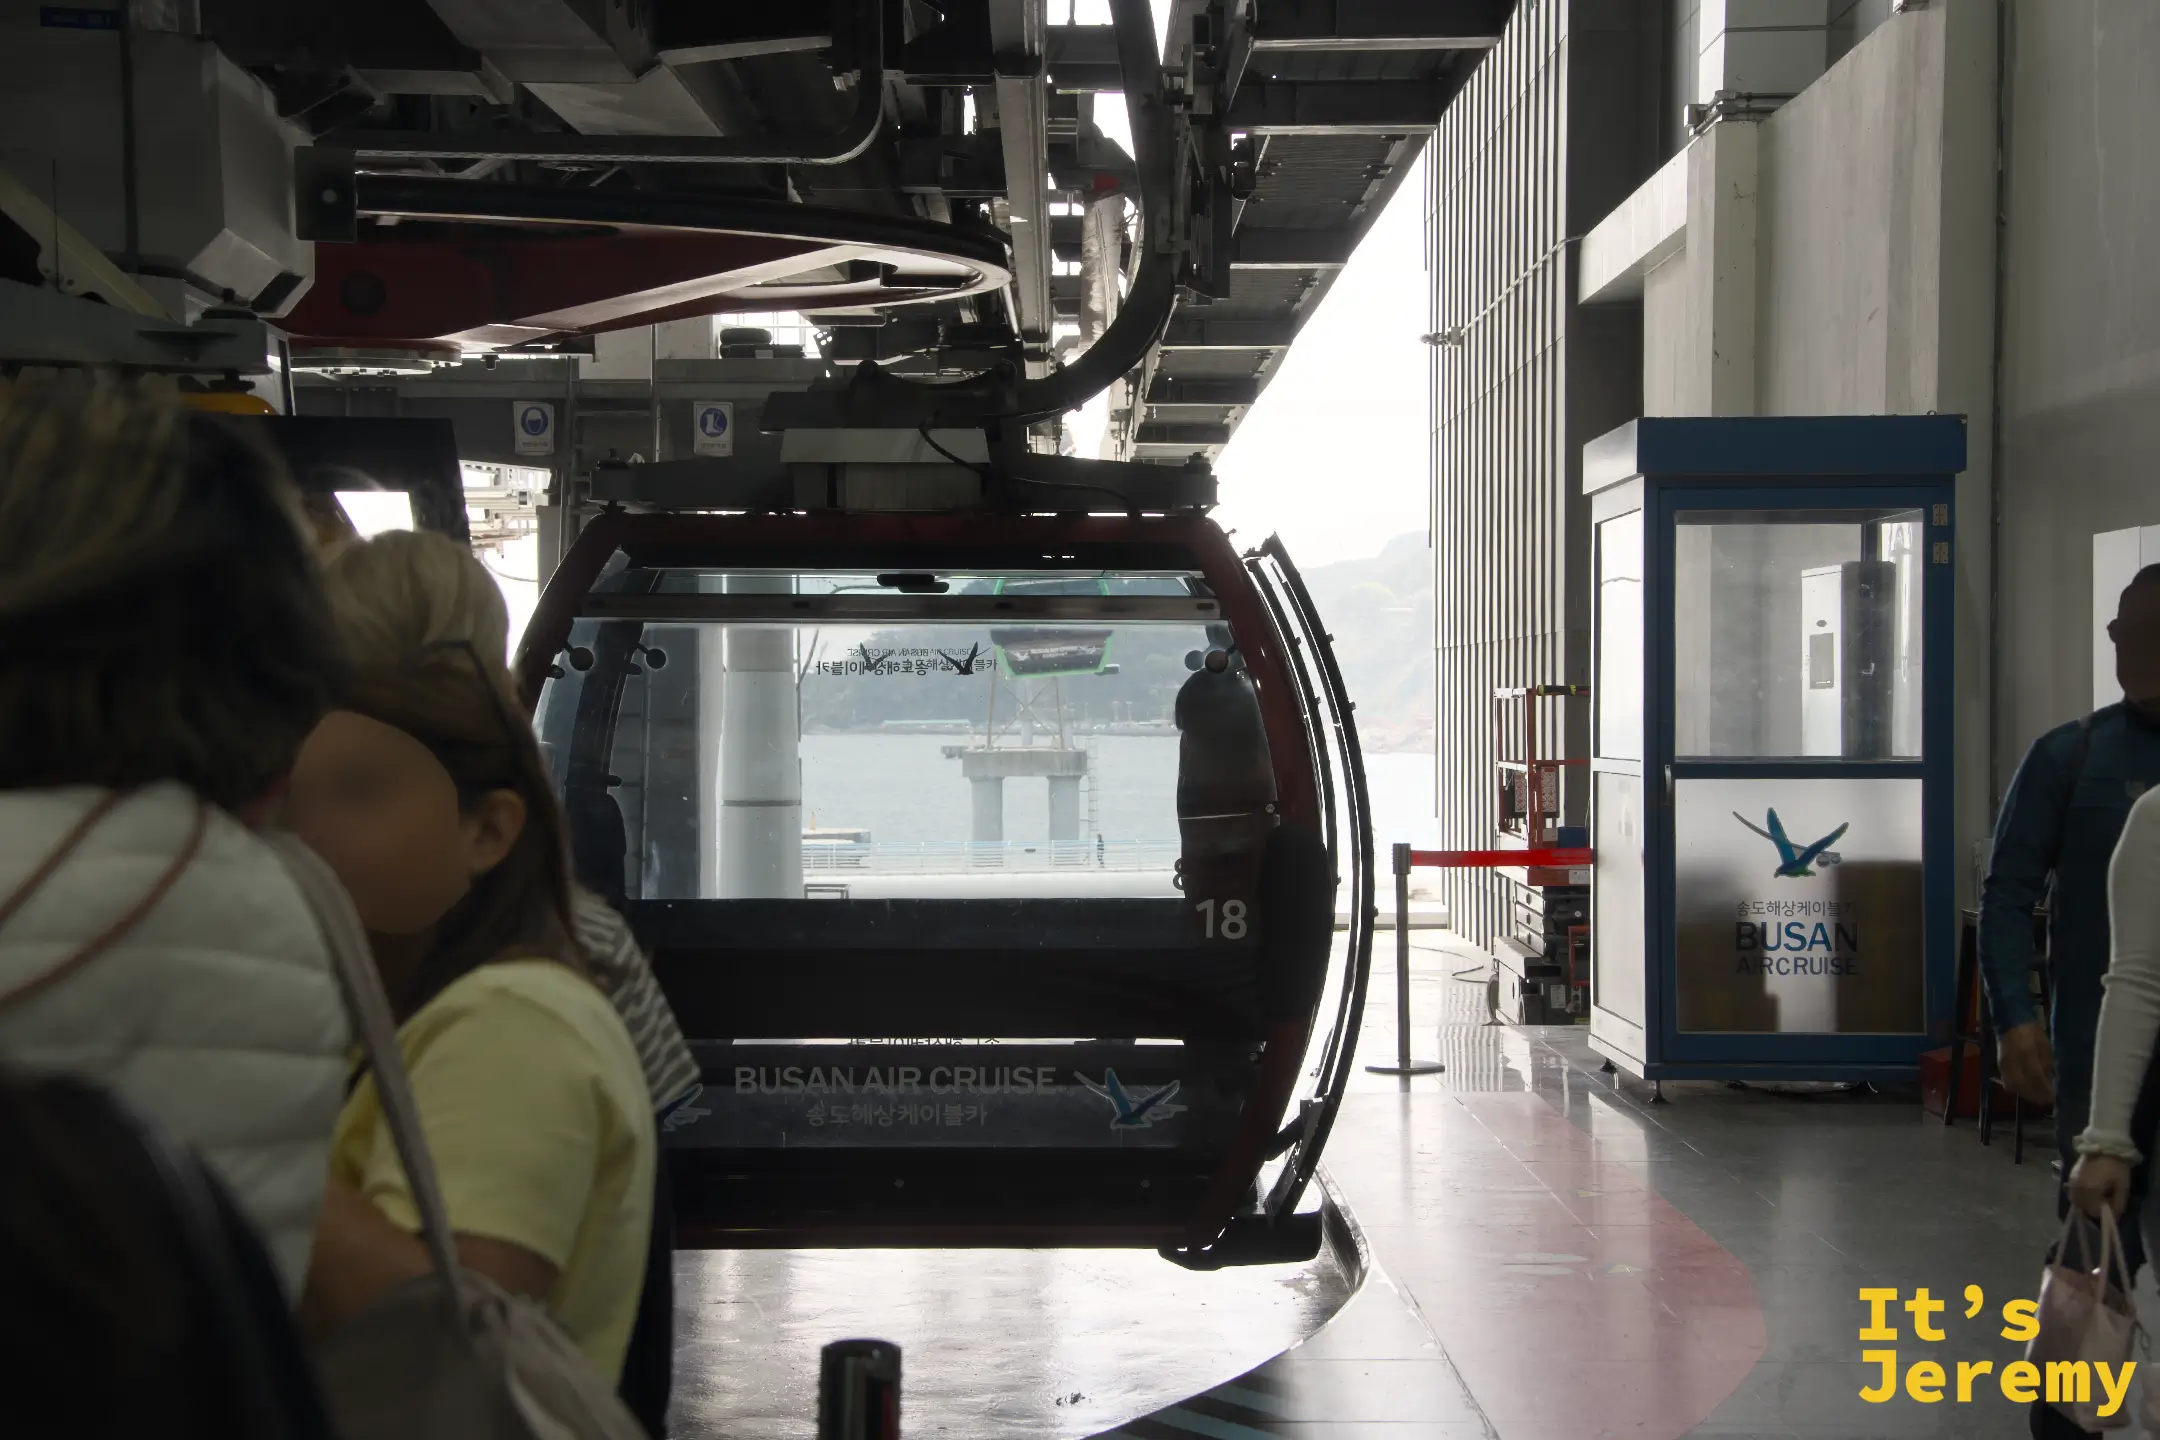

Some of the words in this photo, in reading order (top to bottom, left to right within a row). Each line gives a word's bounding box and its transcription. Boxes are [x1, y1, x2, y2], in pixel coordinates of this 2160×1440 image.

[1196, 899, 1247, 940] 18
[1736, 921, 1858, 952] BUSAN
[734, 1066, 854, 1095] BUSAN
[862, 1066, 922, 1095] AIR
[929, 1065, 1057, 1096] CRUISE
[805, 1102, 988, 1127] 송도해상케이블카
